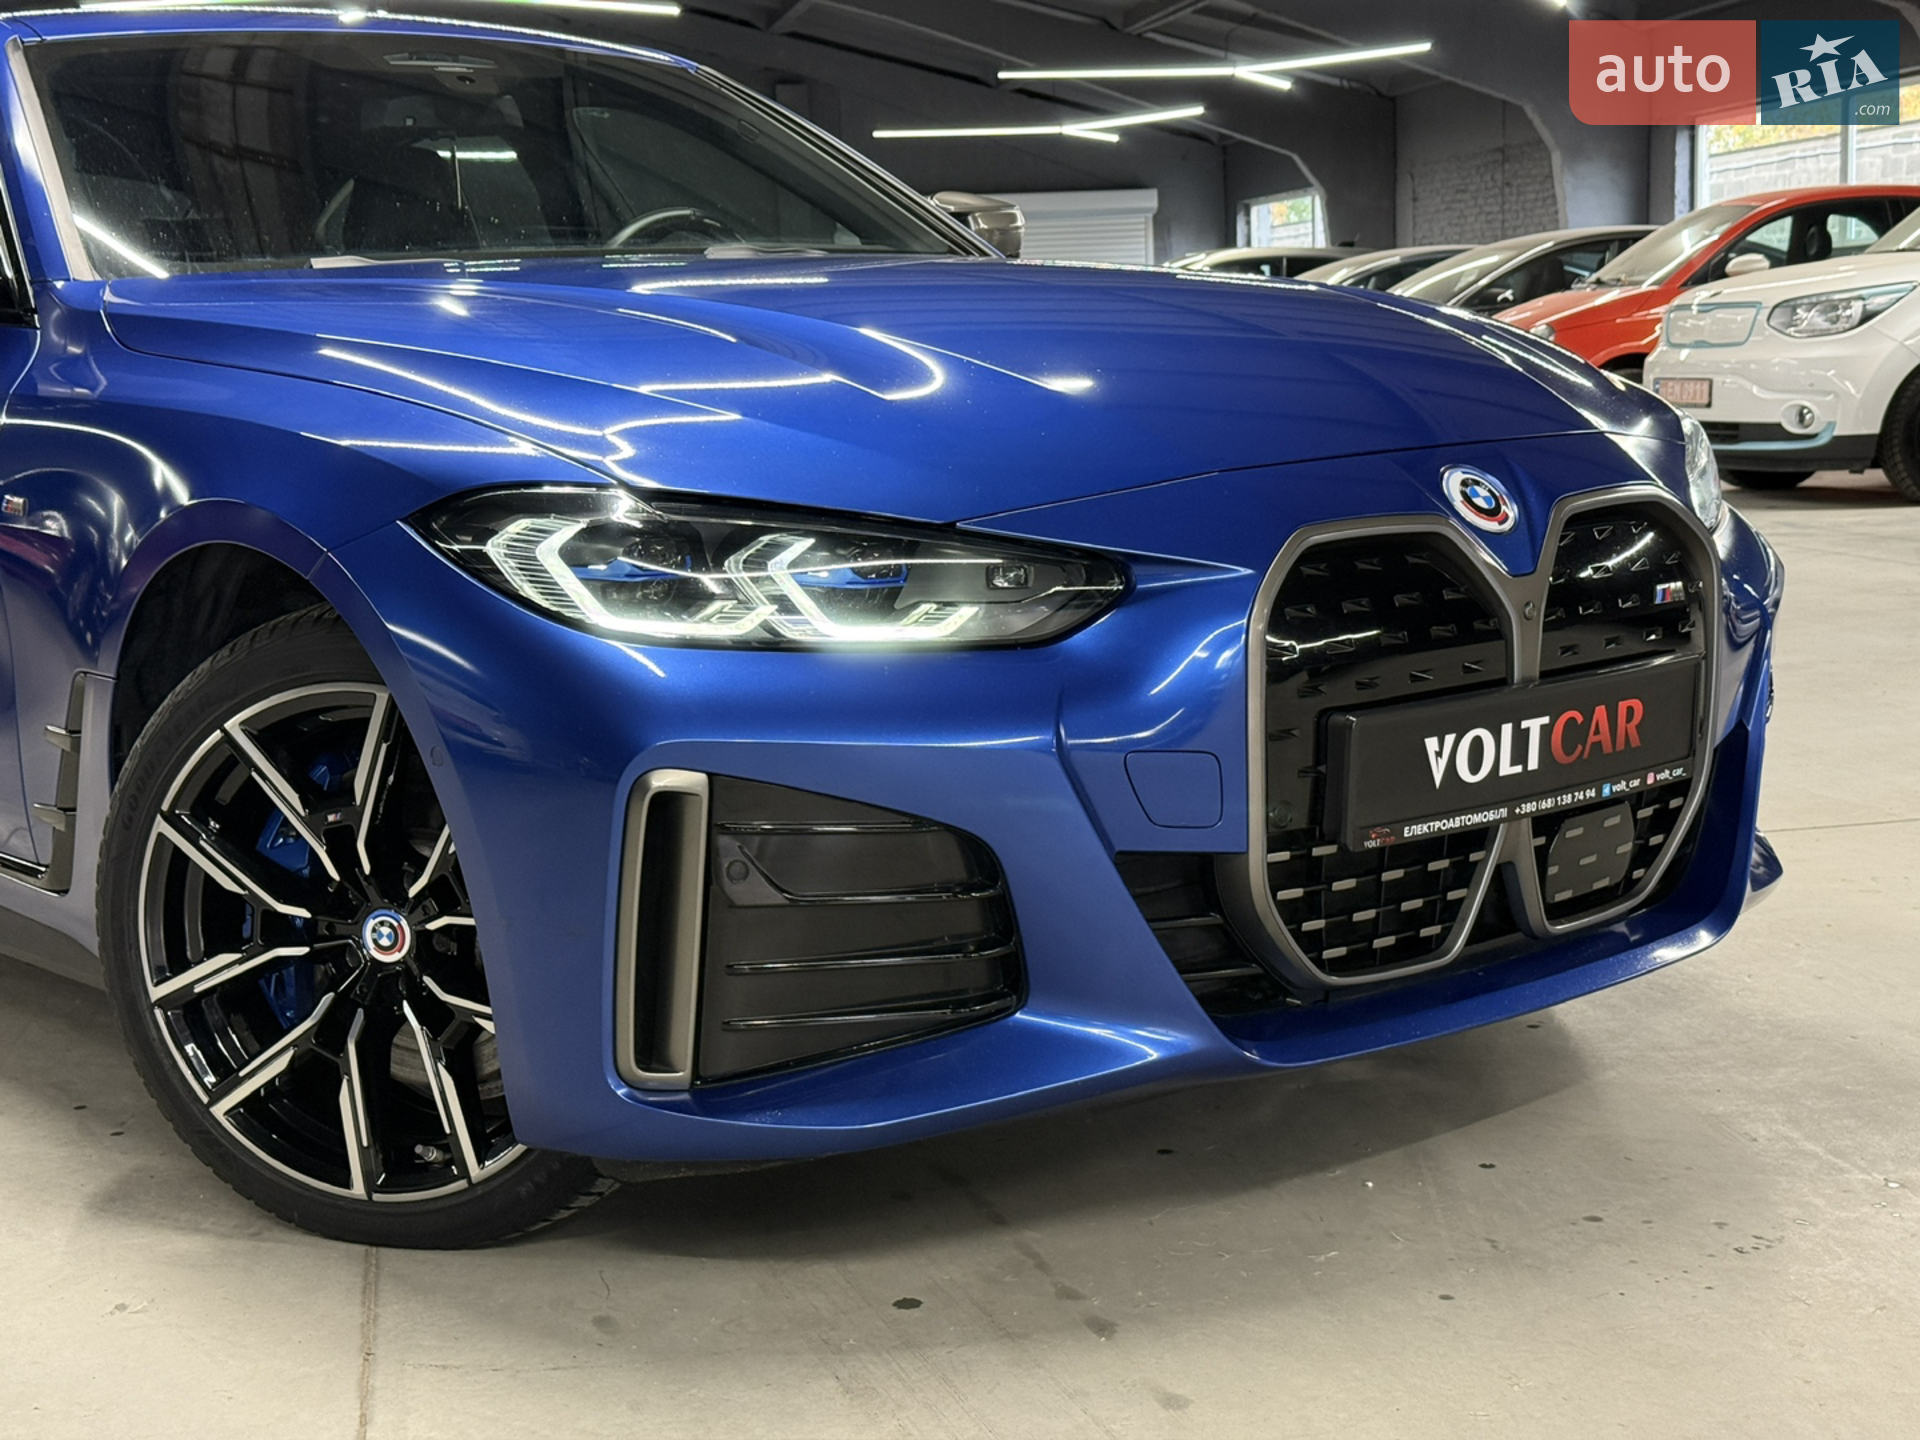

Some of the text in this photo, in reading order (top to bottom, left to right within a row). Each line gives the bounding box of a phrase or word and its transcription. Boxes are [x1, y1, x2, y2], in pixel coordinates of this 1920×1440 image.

[1424, 698, 1644, 789] VOLTCAR
[1612, 777, 1641, 792] volt_car
[1514, 801, 1537, 815] +380
[1556, 793, 1572, 806] 138
[1574, 790, 1585, 803] 74
[1585, 788, 1596, 799] 94
[1404, 807, 1508, 838] ЕЛЕКТРОАВТОМОБІЛІ
